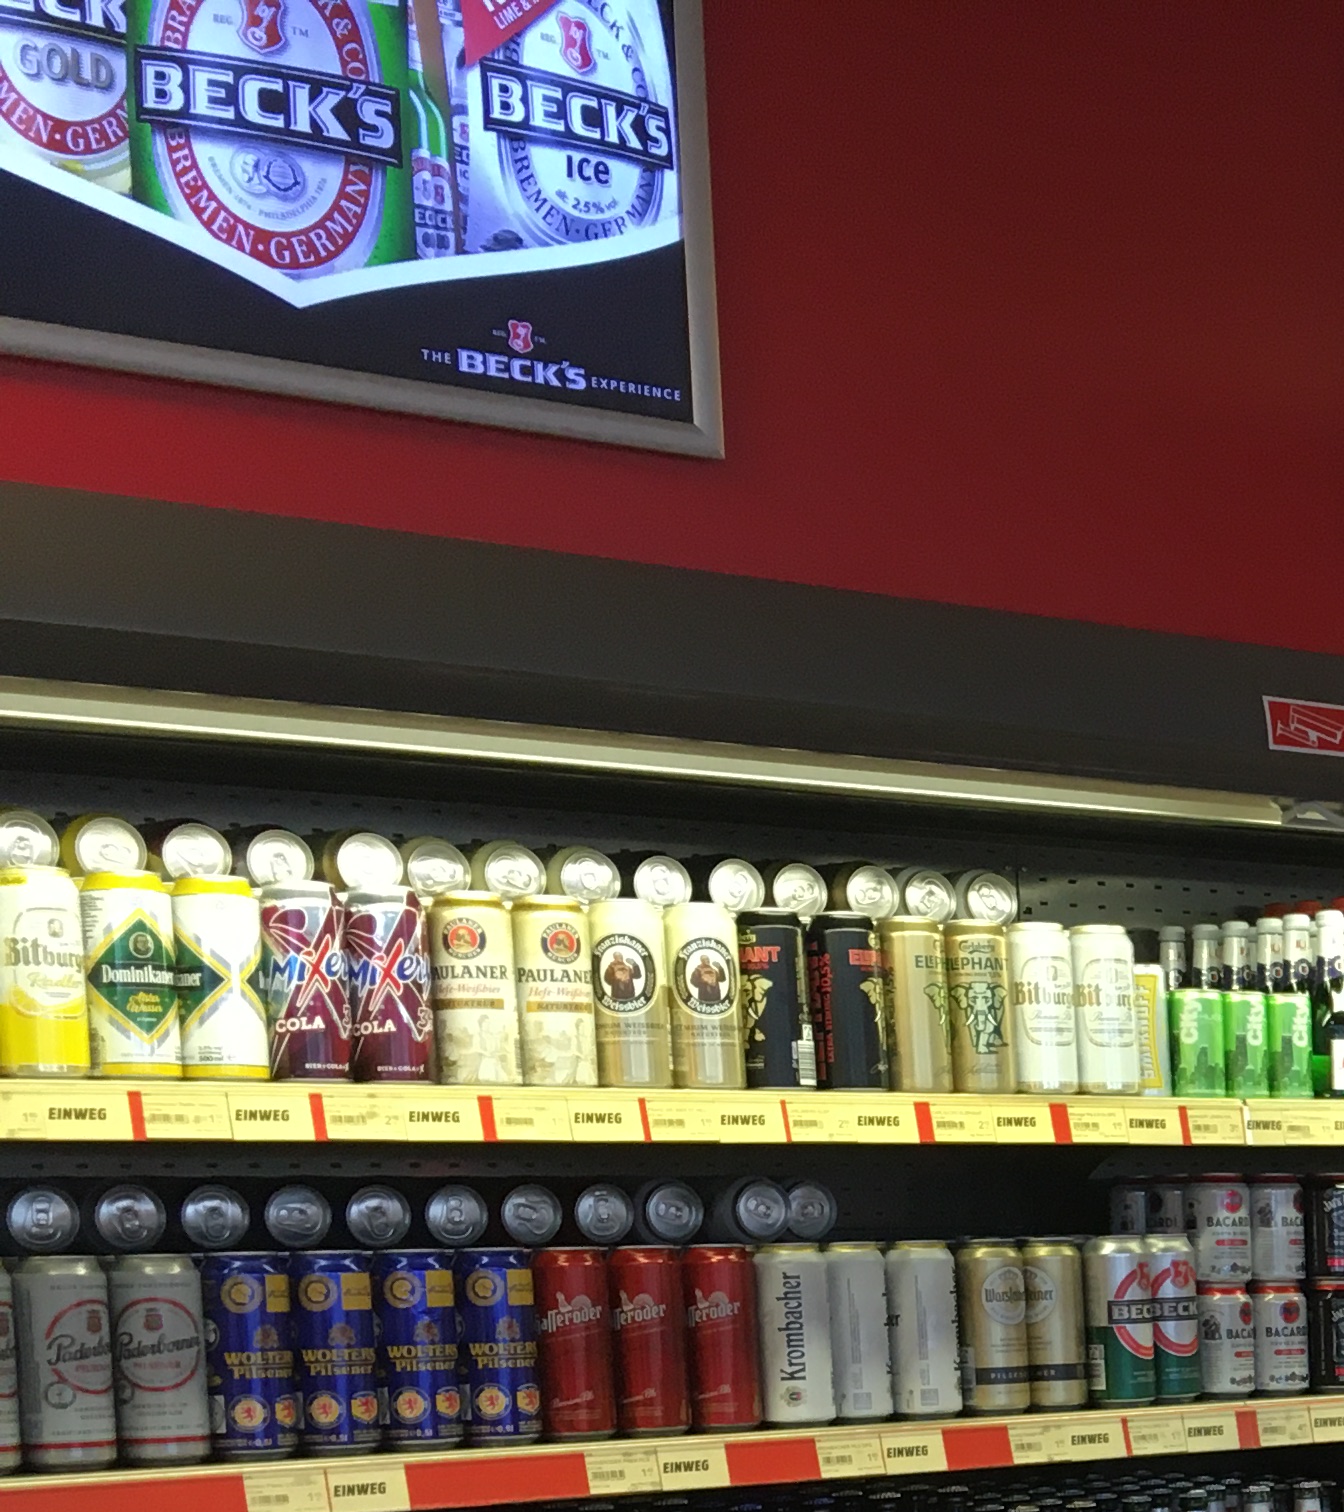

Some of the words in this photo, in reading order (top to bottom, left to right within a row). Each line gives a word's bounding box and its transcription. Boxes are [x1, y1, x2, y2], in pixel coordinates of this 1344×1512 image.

[16, 39, 113, 89] GOLD
[142, 59, 395, 149] BECK'S
[486, 72, 670, 157] BECK'S
[167, 126, 261, 251] BREMEN
[269, 161, 370, 263] GERMANY
[511, 138, 572, 239] BREMEN
[421, 349, 451, 366] THE
[458, 348, 586, 391] BECK'S
[591, 375, 681, 401] EXPERIENCE
[275, 1017, 325, 1033] COLA
[353, 1020, 396, 1035] COLA
[48, 1107, 107, 1123] EINWEG
[408, 1111, 460, 1123] EINWEG
[720, 1114, 766, 1128] EINWEG
[779, 1271, 802, 1382] Krombacher
[301, 1349, 376, 1365] WOLTERS
[387, 1344, 458, 1360] WOLTERS
[886, 1444, 929, 1459] EINWEG
[333, 1481, 387, 1498] EINWEG
